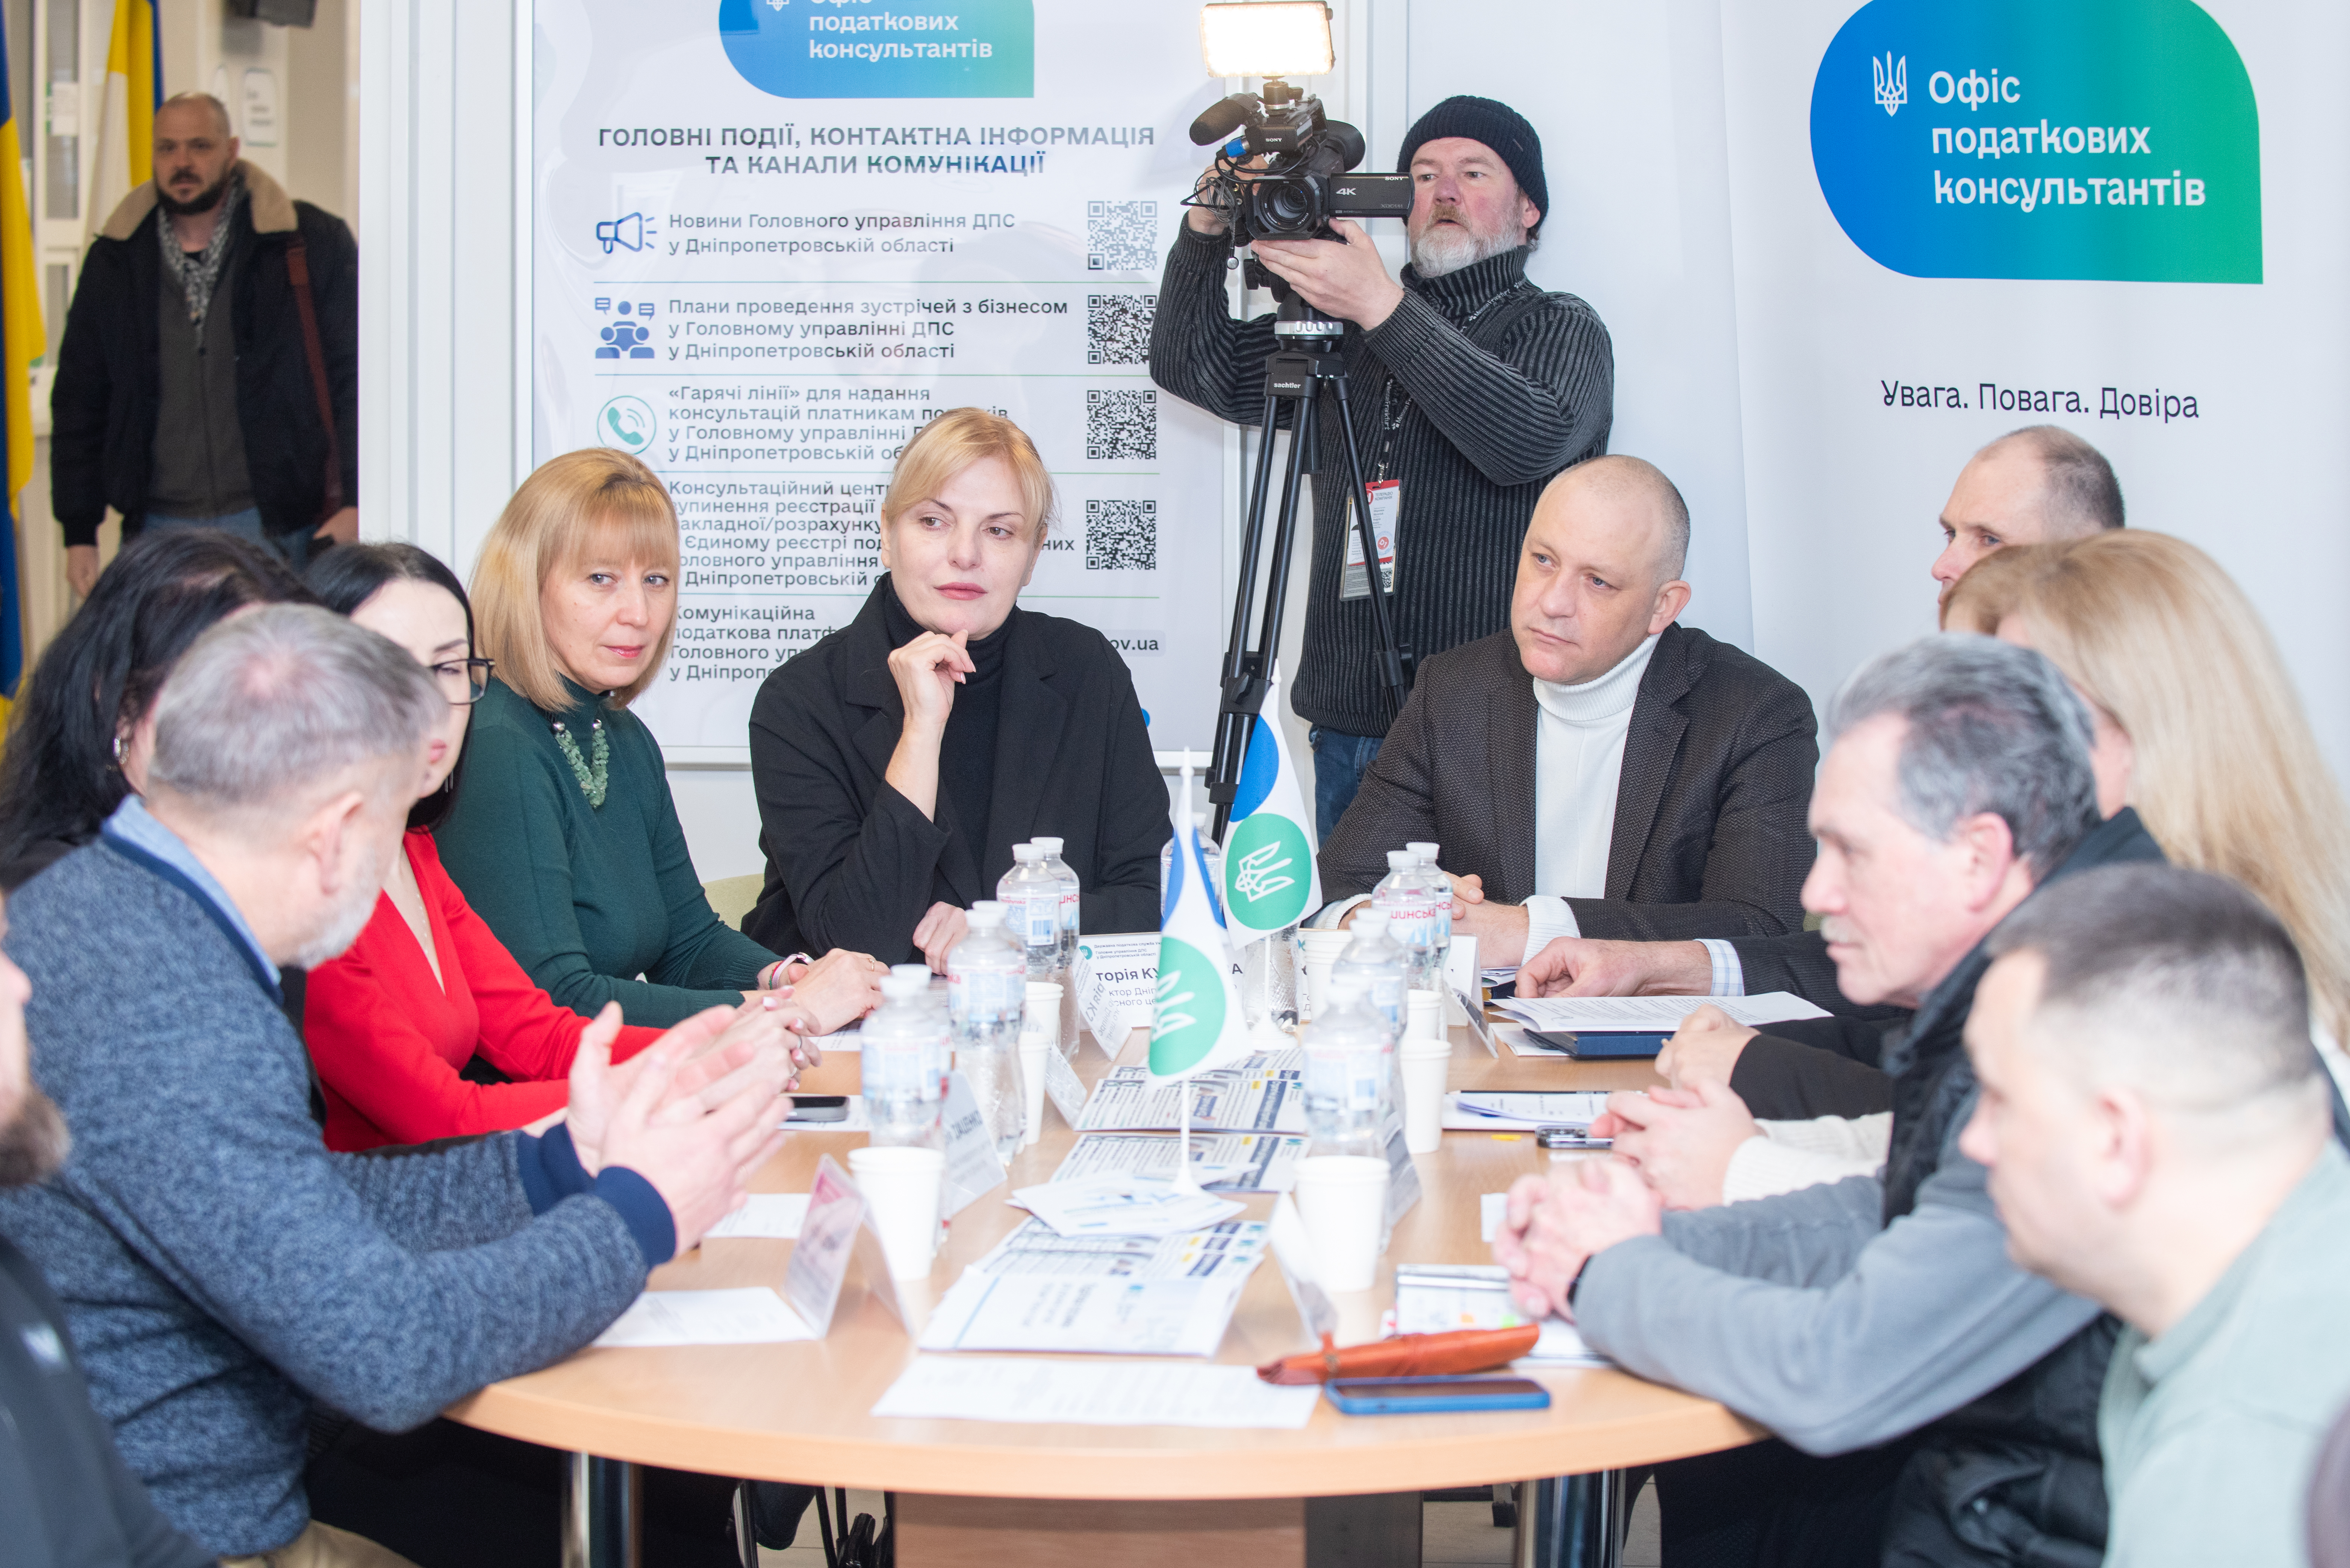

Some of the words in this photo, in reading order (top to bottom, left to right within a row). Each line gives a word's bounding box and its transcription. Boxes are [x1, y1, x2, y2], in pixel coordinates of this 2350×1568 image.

[809, 12, 959, 34] податкових
[809, 39, 993, 63] консультантів
[1928, 68, 2021, 111] Офіс
[600, 128, 711, 146] ГОЛОВНІ
[722, 123, 801, 149] ПОДІЇ,
[811, 127, 972, 146] КОНТАКТНА
[981, 127, 1155, 148] ІНФОРМАЦІЯ
[1931, 119, 2152, 159] податкових
[705, 156, 739, 174] ТА
[748, 156, 857, 174] КАНАЛИ
[868, 151, 1046, 177] КОМУНІКАЦІЇ
[1934, 170, 2206, 213] консультантів
[669, 214, 742, 228] Новини
[749, 214, 849, 228] Головного
[855, 213, 966, 230] управління
[973, 213, 1015, 230] ДПС
[669, 240, 679, 255] у
[686, 238, 875, 255] Дніпропетровській
[881, 237, 953, 253] області
[669, 299, 729, 313] Плани
[737, 302, 854, 316] проведення
[860, 299, 956, 317] зустрічей
[962, 302, 972, 313] з
[978, 299, 1068, 313] бізнесом
[669, 324, 679, 339] у
[686, 322, 794, 339] Головному
[800, 321, 906, 339] управлінні
[912, 322, 955, 338] ДПС
[669, 346, 679, 361] у
[685, 343, 874, 361] Дніпропетровській
[881, 343, 955, 358] області
[669, 386, 741, 402] «Гарячі
[748, 385, 800, 400] лінії»
[806, 389, 841, 402] для
[849, 389, 930, 402] надання
[1881, 380, 1968, 408] Увага.
[1979, 383, 2089, 413] Повага.
[2100, 387, 2199, 423] Довіра
[669, 405, 800, 423] консультацій
[807, 408, 915, 420] платникам
[669, 428, 679, 443] у
[686, 426, 794, 443] Головному
[800, 425, 905, 443] управлінні
[669, 448, 679, 462] у
[685, 445, 874, 462] Дніпропетровській
[669, 481, 834, 497] Консультаційний
[841, 484, 890, 497] цент
[676, 502, 769, 515] упинення
[776, 499, 876, 516] реєстрації
[681, 517, 881, 533] акладної/розрахунку
[685, 535, 770, 550] Єдиному
[776, 535, 847, 551] реєстрі
[681, 555, 765, 567] оловного
[771, 554, 879, 570] управління
[685, 571, 867, 587] Дніпропетровській
[671, 645, 769, 659] Головного
[669, 667, 680, 682] у
